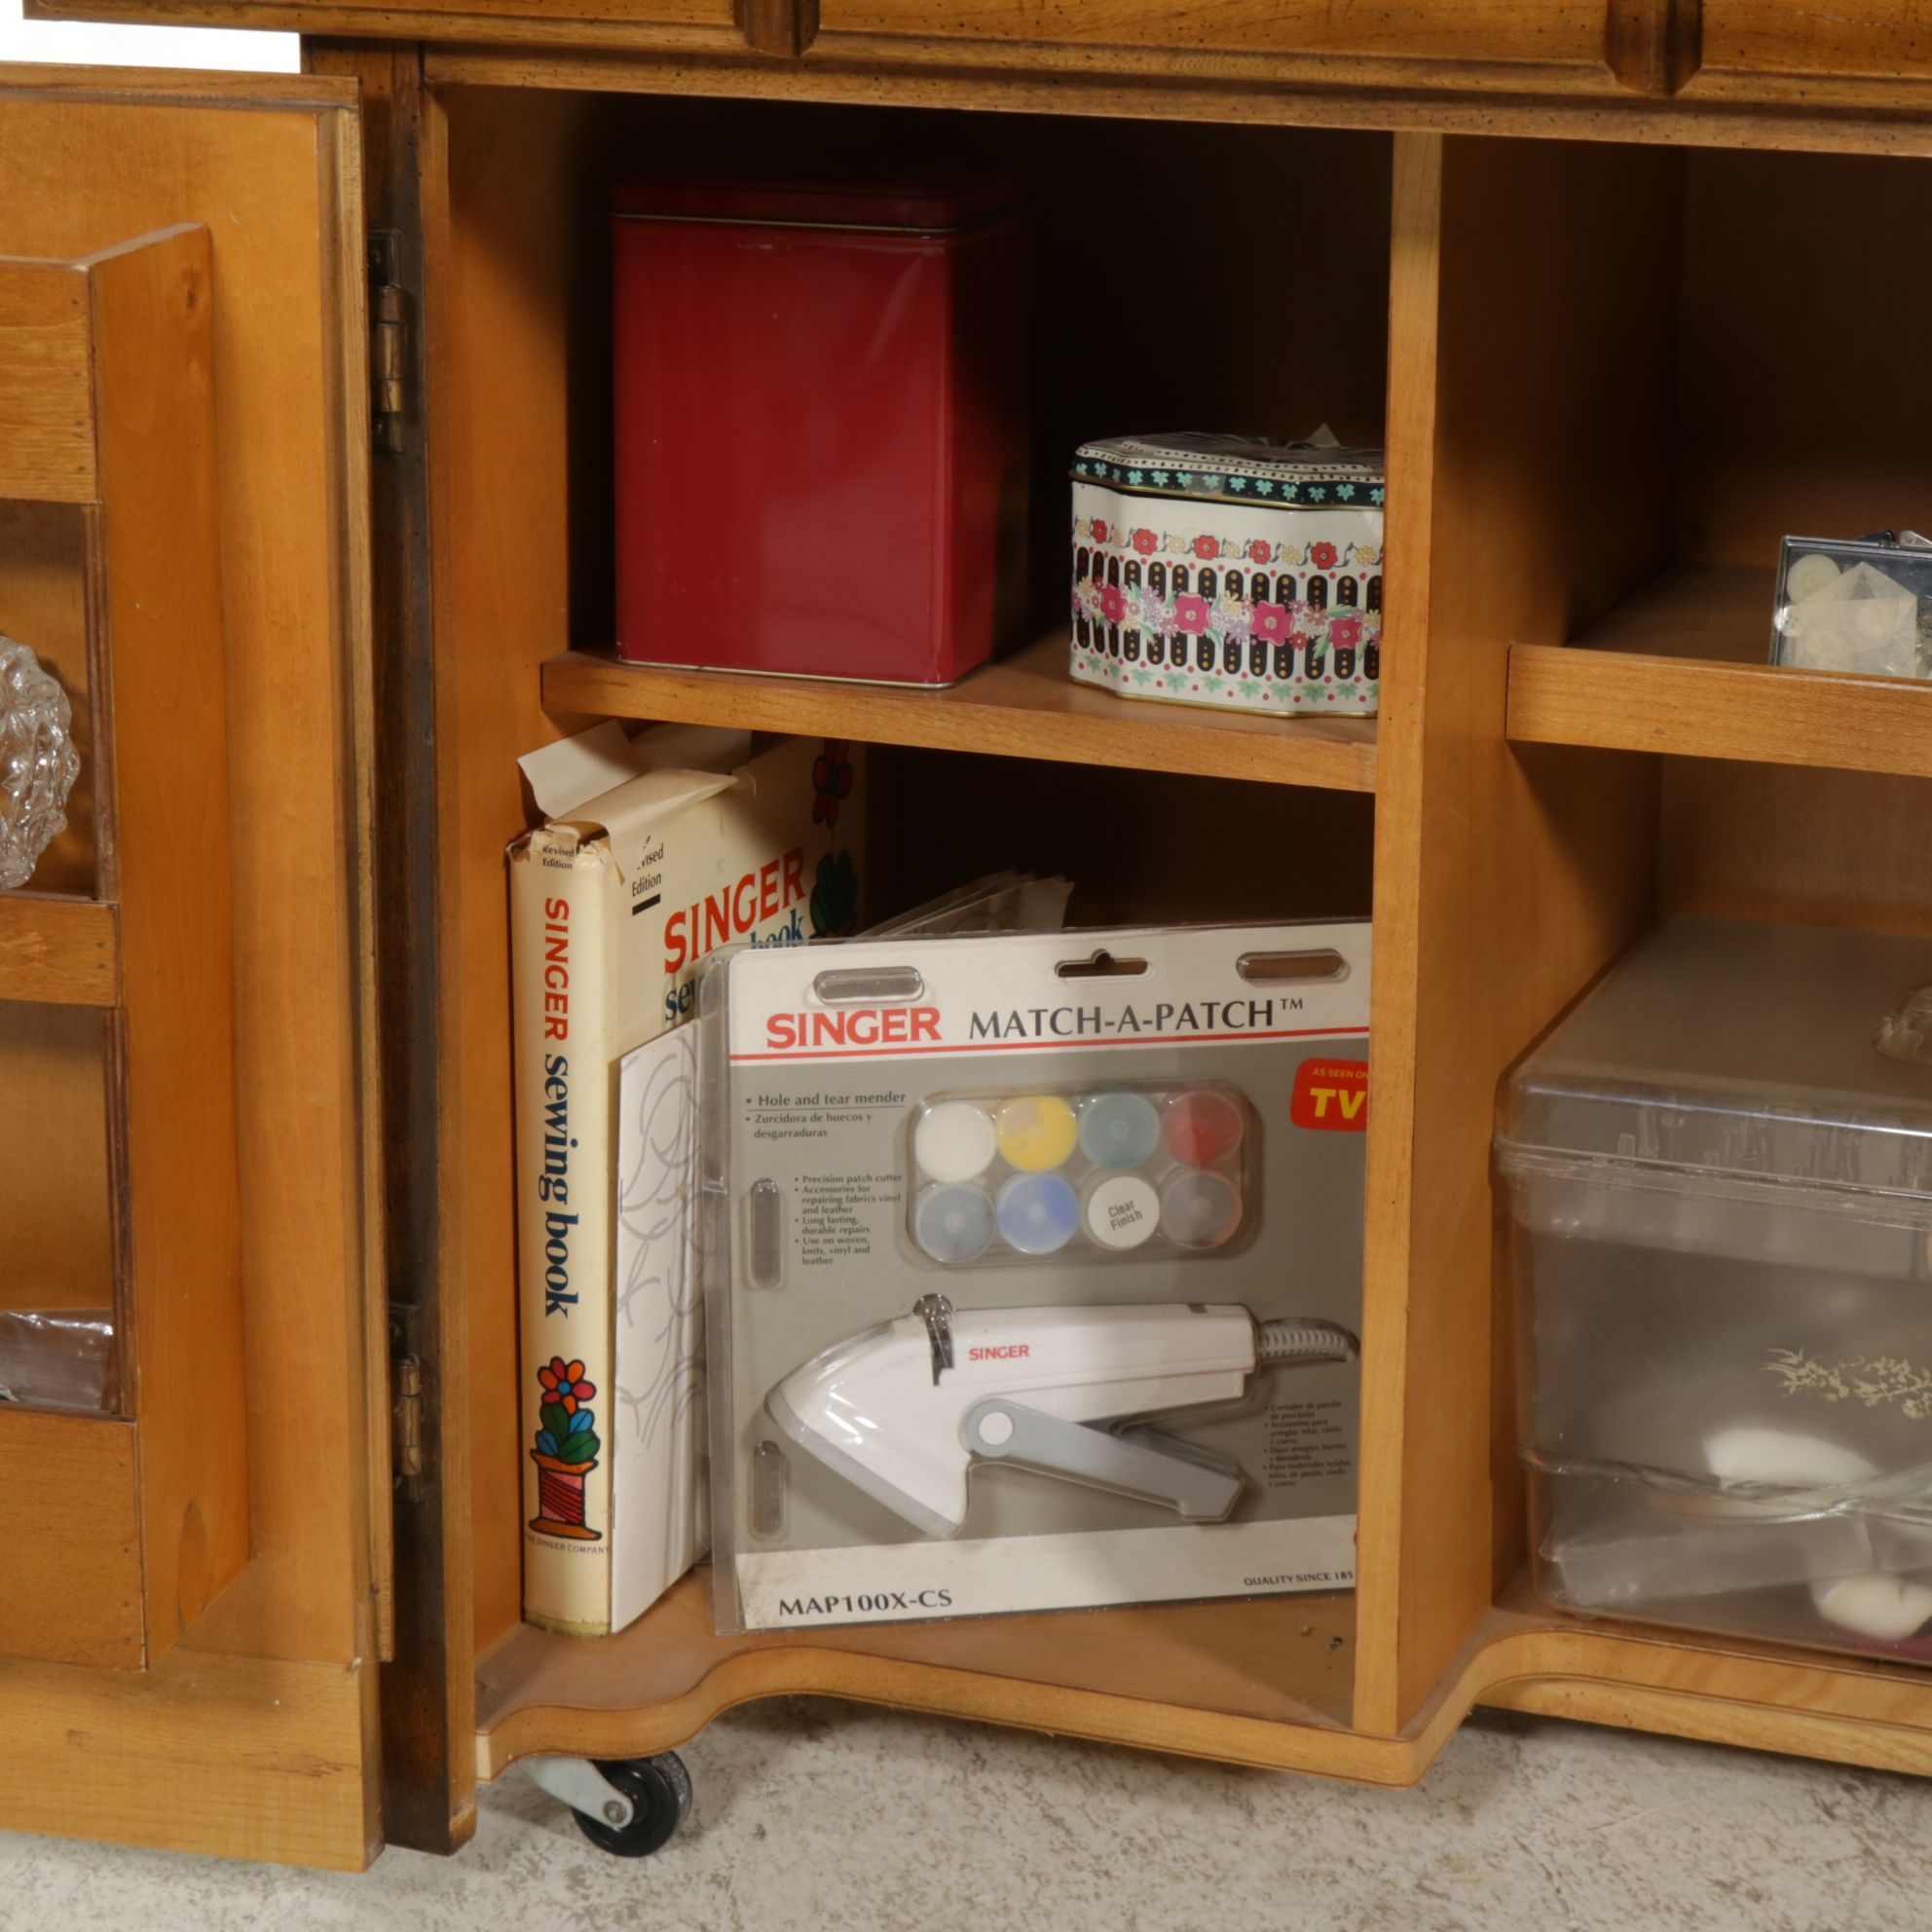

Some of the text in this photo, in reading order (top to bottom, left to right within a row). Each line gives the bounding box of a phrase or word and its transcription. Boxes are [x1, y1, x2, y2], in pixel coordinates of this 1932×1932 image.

[637, 841, 664, 871] vised
[542, 858, 573, 870] Edition
[632, 873, 662, 897] Edition
[664, 847, 806, 975] SINGER
[766, 1006, 943, 1050] SINGER
[969, 999, 1273, 1040] MATCH-A-PATCH
[1313, 1067, 1325, 1077] AS
[1327, 1068, 1354, 1078] SEEN
[758, 1091, 906, 1106] Hole and tear mender
[1310, 1088, 1366, 1119] TV
[539, 897, 579, 1319] SINGER sewing book
[755, 1111, 873, 1124] Zurcidora de huecos y
[754, 1128, 828, 1140] desgarraduras
[802, 1174, 844, 1183] Precision
[846, 1174, 873, 1185] patch
[857, 1184, 871, 1193] for
[802, 1193, 901, 1206] repairing fabrics vinyl
[802, 1205, 853, 1214] and leather
[1108, 1200, 1134, 1218] Clear
[802, 1216, 825, 1226] Long
[1110, 1209, 1143, 1231] Finish
[802, 1225, 871, 1235] durable repairs
[829, 1245, 851, 1256] vinyl
[853, 1245, 871, 1254] and
[969, 1344, 1030, 1361] SINGER
[537, 1538, 566, 1551] SINGER
[1244, 1570, 1355, 1586] QUALITY SINCE 185
[779, 1588, 952, 1616] MAP100X-CS
